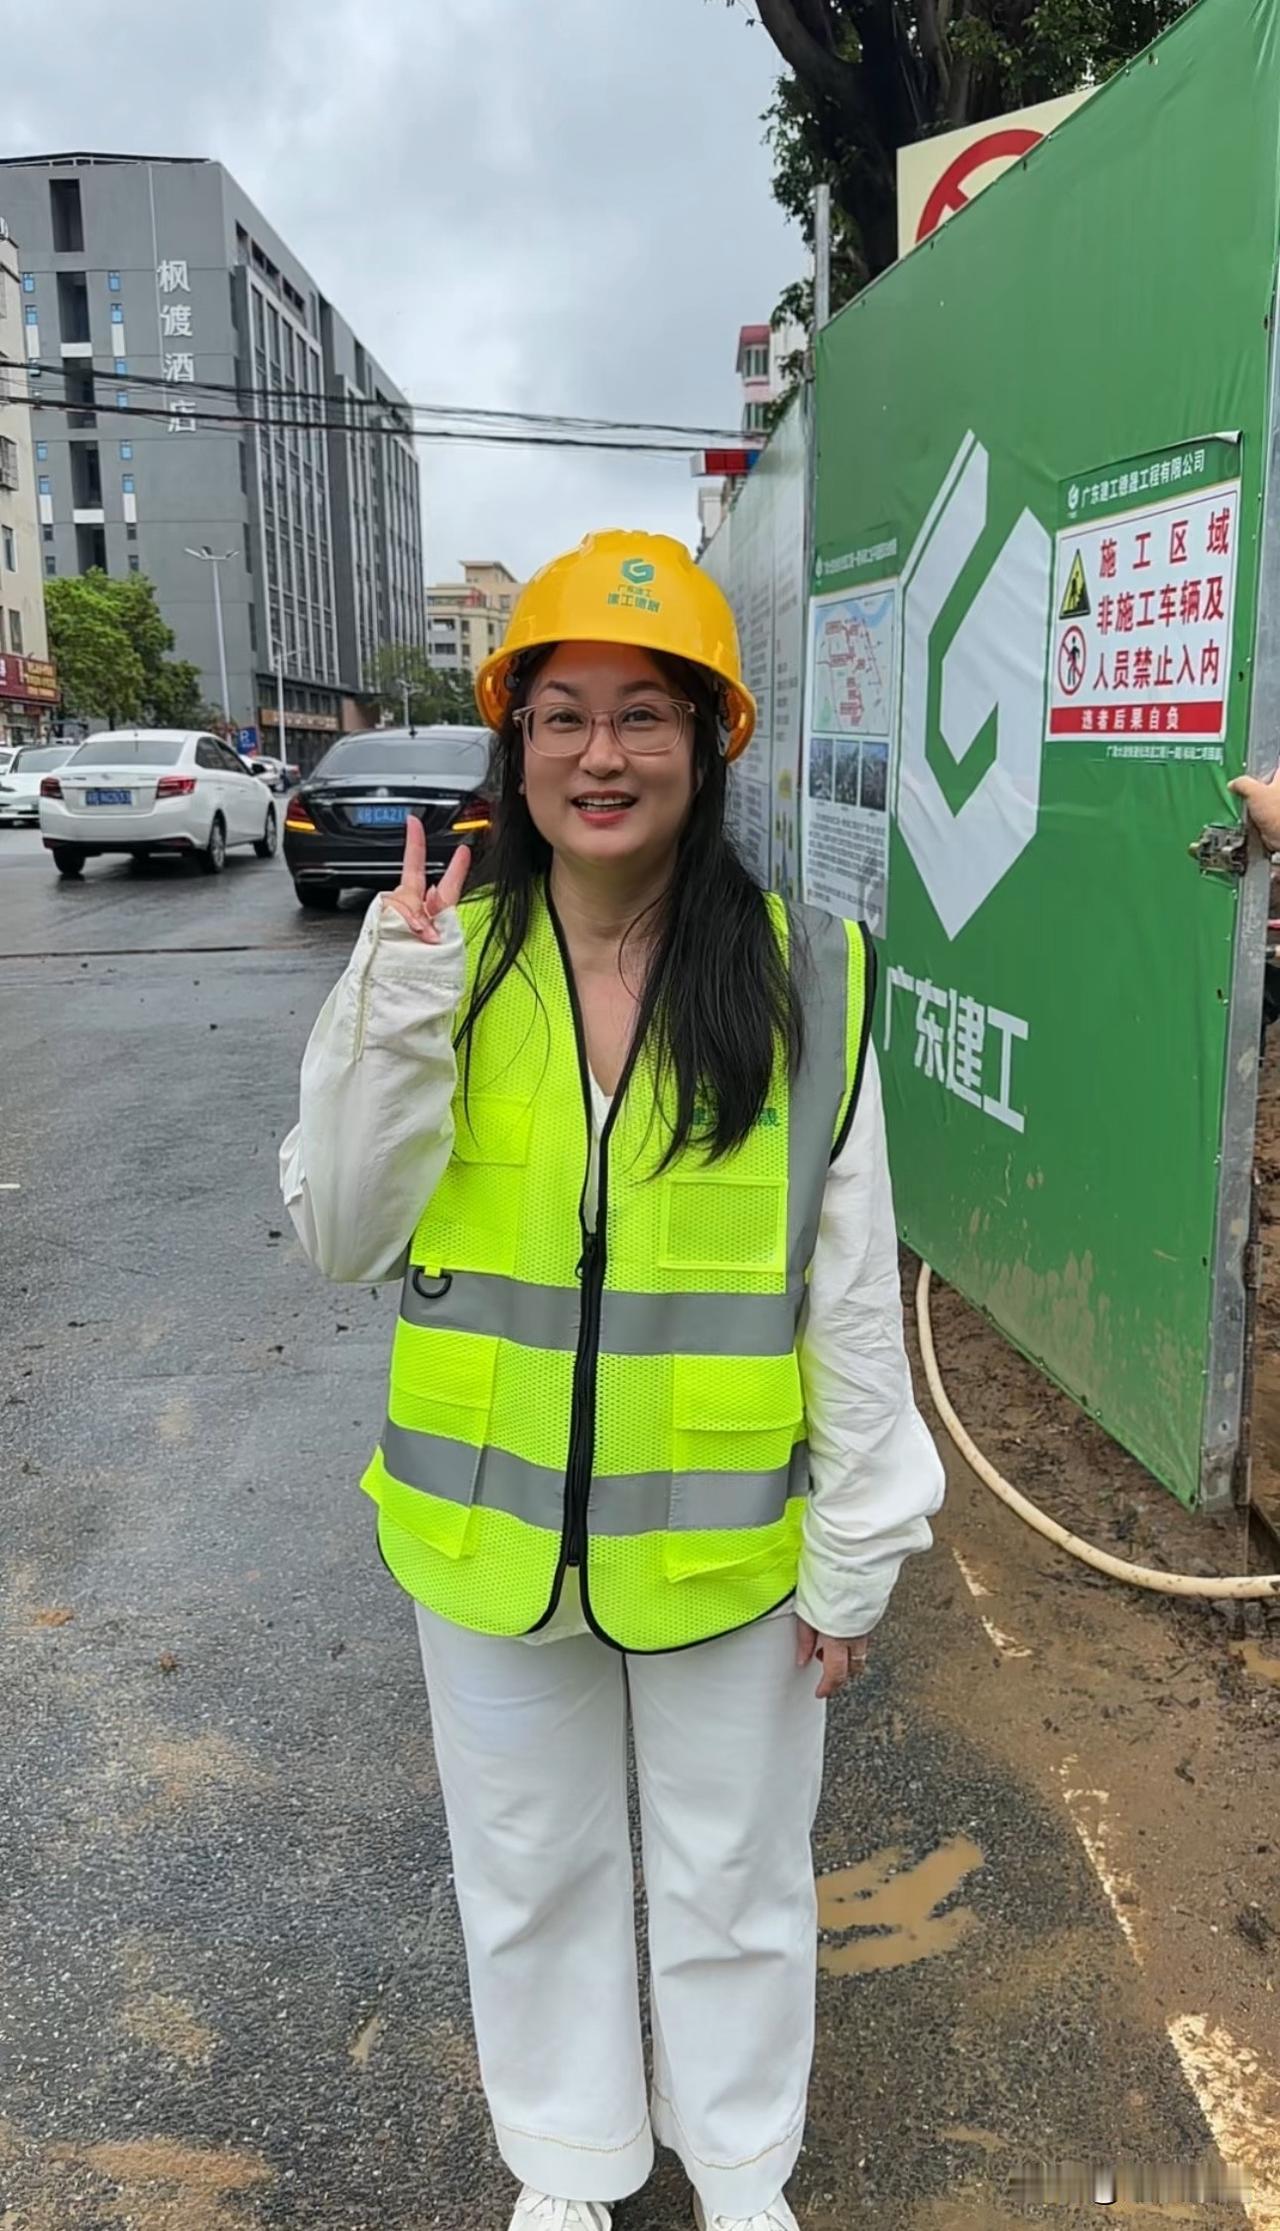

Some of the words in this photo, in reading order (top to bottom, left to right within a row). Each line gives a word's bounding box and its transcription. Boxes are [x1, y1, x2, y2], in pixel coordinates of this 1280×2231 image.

[156, 259, 197, 433] 枫渡酒店
[1099, 507, 1230, 578] 施工区域
[1096, 575, 1224, 635] 非施工车辆及
[1093, 638, 1220, 691] 人员禁止入内
[1081, 706, 1179, 731] 违者后果自负
[884, 965, 1029, 1134] 广东建工
